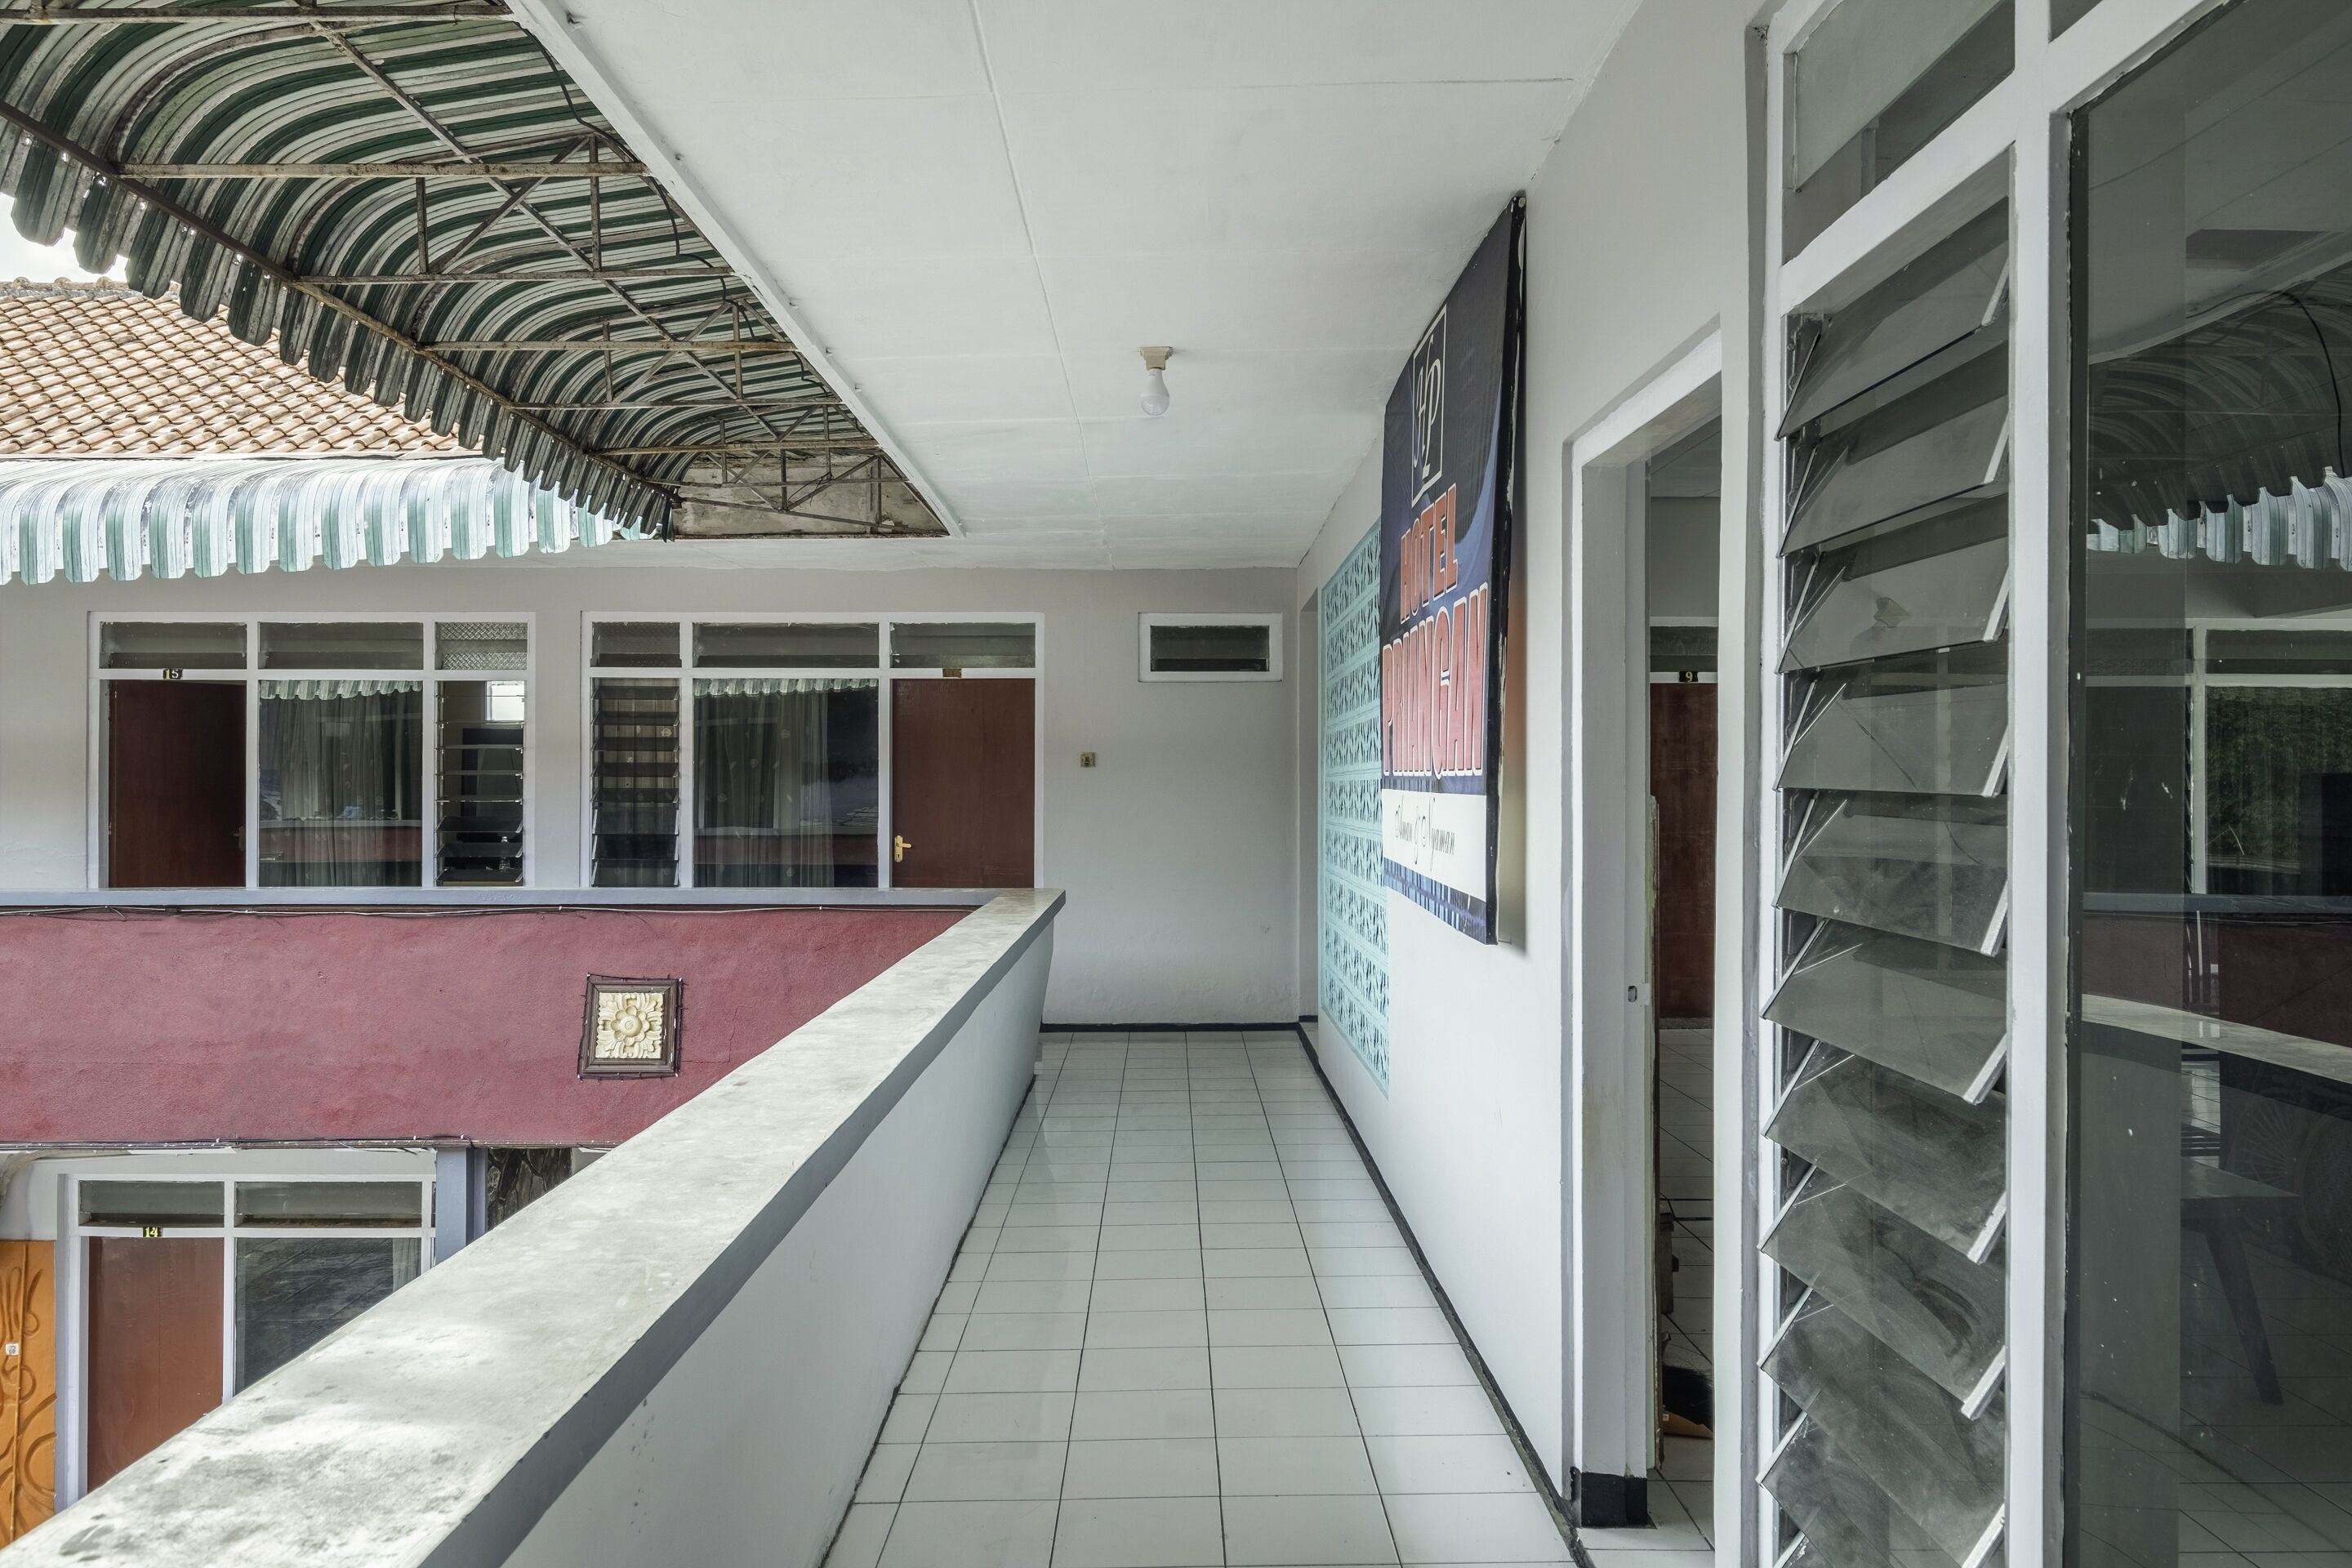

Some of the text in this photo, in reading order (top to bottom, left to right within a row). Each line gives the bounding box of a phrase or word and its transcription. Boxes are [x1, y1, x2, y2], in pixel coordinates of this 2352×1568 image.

[1400, 482, 1458, 625] HOTEL
[165, 668, 179, 679] 15
[1685, 671, 1693, 682] 9
[1383, 581, 1488, 779] PRIANGAN
[145, 1227, 158, 1238] 14
